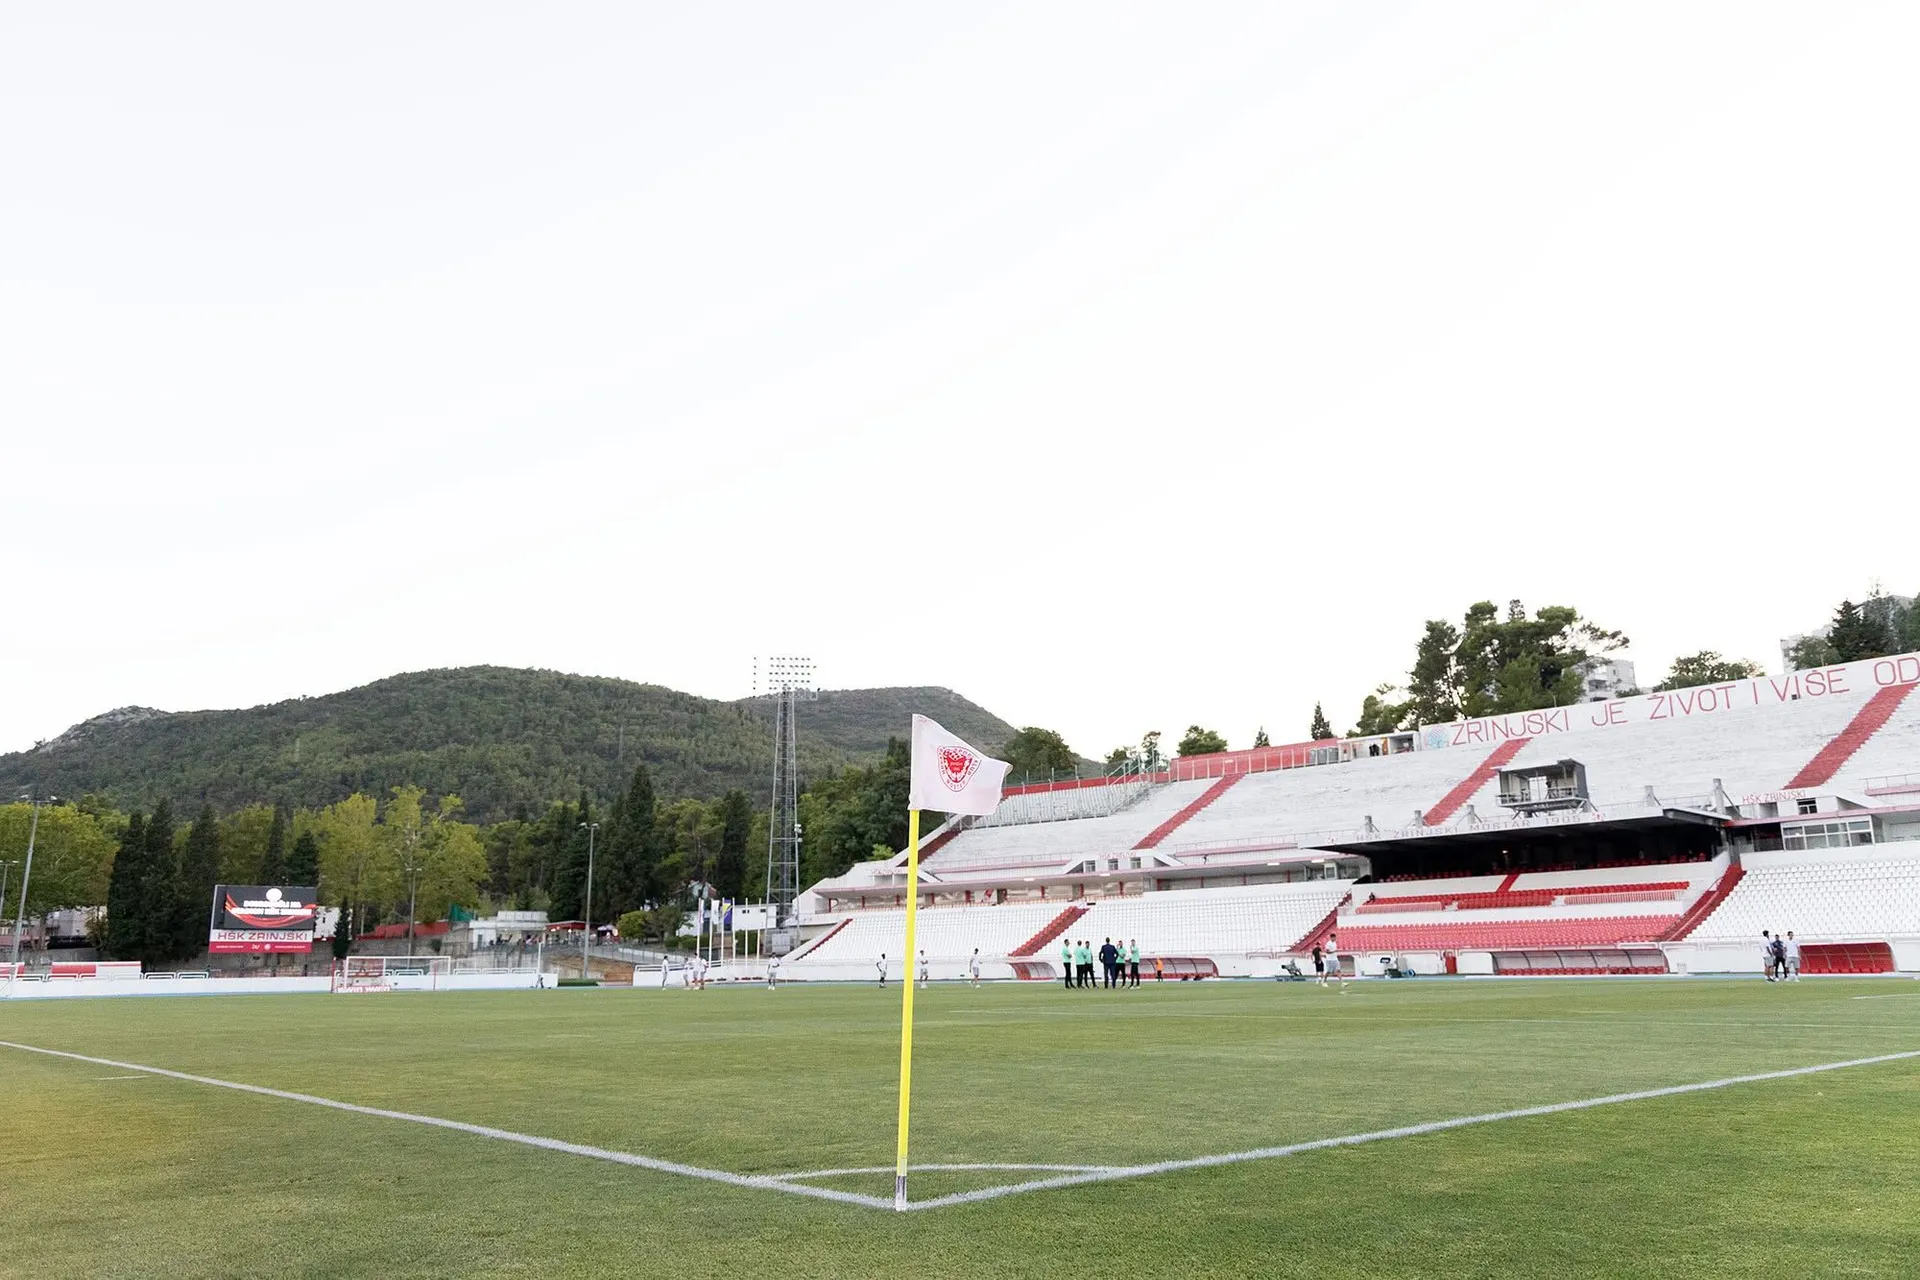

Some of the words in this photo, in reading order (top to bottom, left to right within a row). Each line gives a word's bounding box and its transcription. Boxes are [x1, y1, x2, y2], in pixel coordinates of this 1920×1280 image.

[1450, 709, 1571, 746] ZRINJSKI
[1591, 701, 1629, 727] JE
[1646, 684, 1737, 720] ŽIVOT
[1751, 681, 1759, 705] I
[1769, 668, 1851, 702] VIŠE
[1873, 656, 1920, 686] OD
[1764, 790, 1806, 802] ZRINJSKI
[1392, 826, 1459, 838] ZRINJSKI
[1469, 818, 1532, 832] MOSTAR
[1544, 814, 1582, 826] 1905
[248, 931, 308, 941] ZRINJSKI
